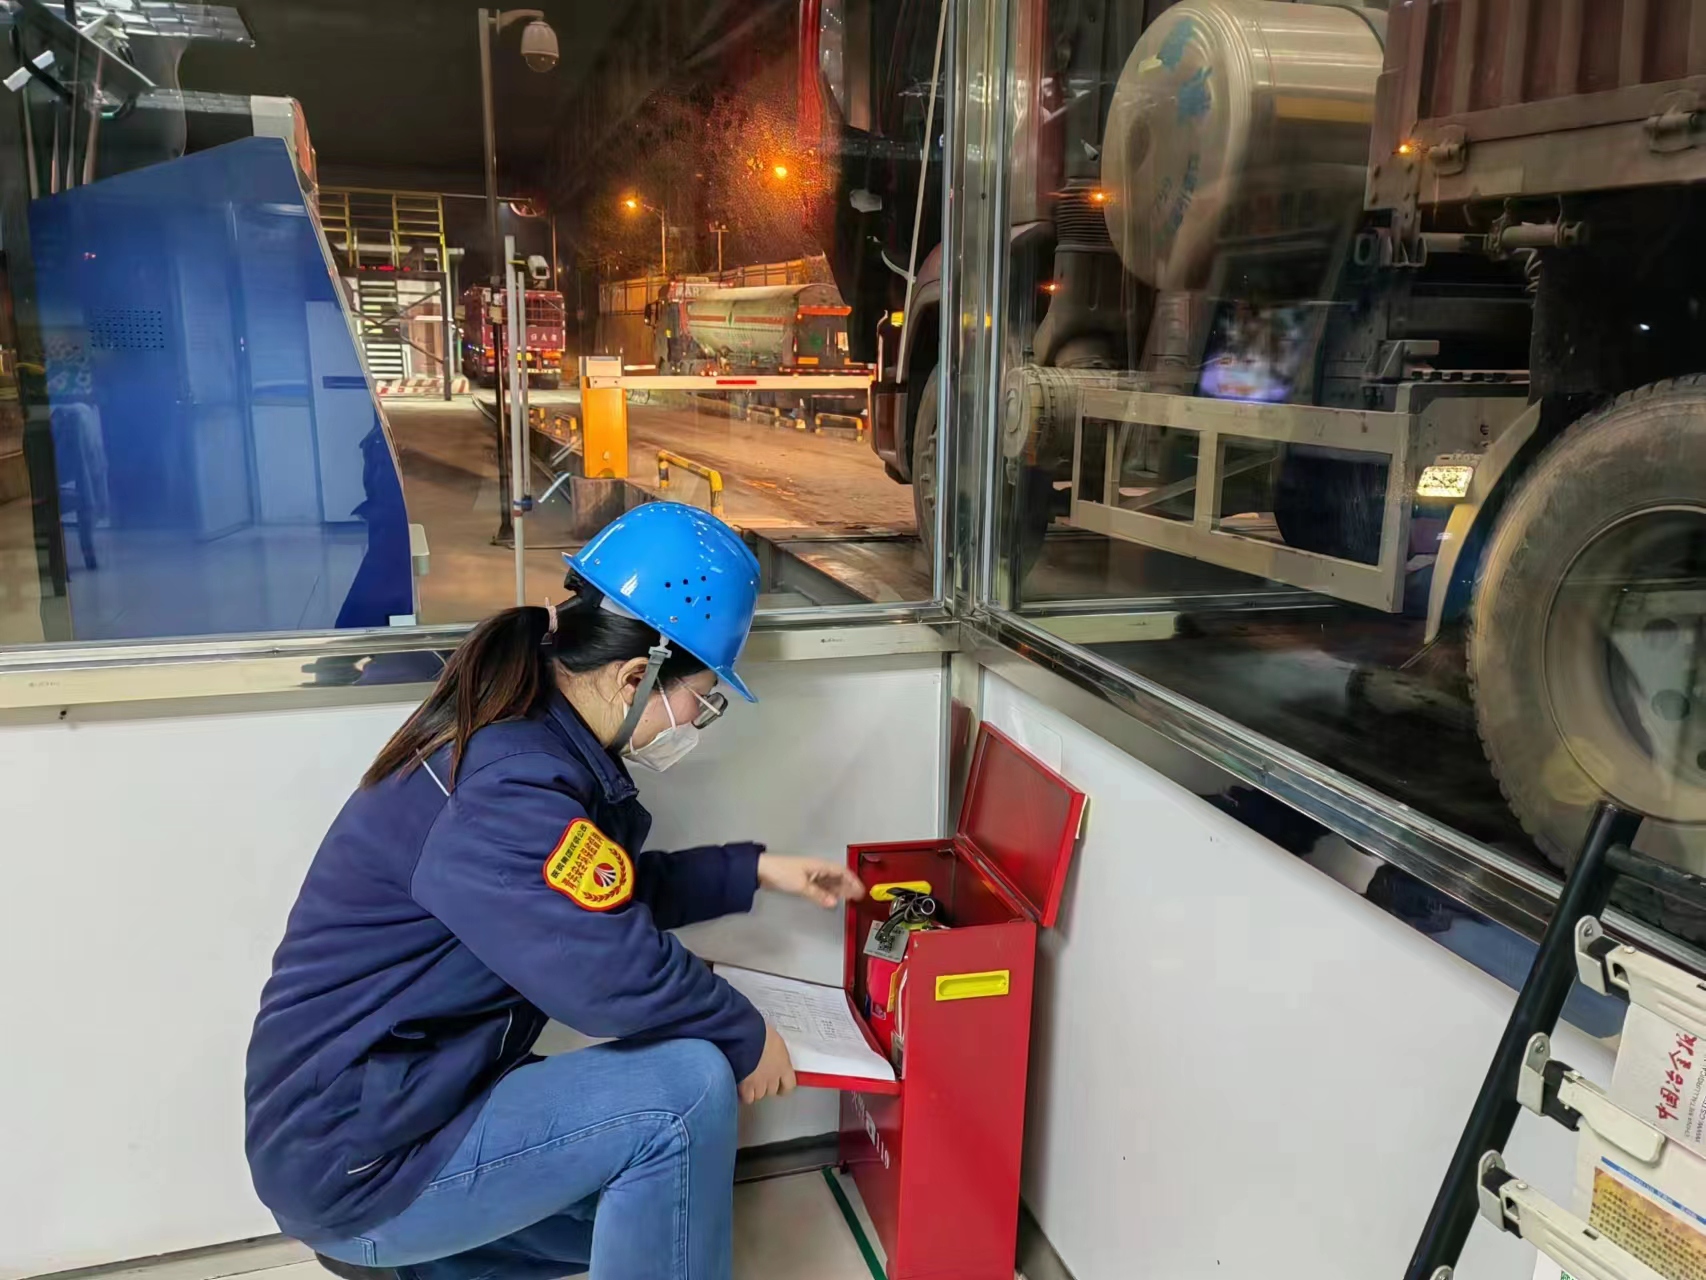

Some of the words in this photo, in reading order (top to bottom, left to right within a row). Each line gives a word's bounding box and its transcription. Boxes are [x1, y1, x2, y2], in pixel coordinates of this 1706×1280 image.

[1655, 1033, 1697, 1120] 中国冶金报
